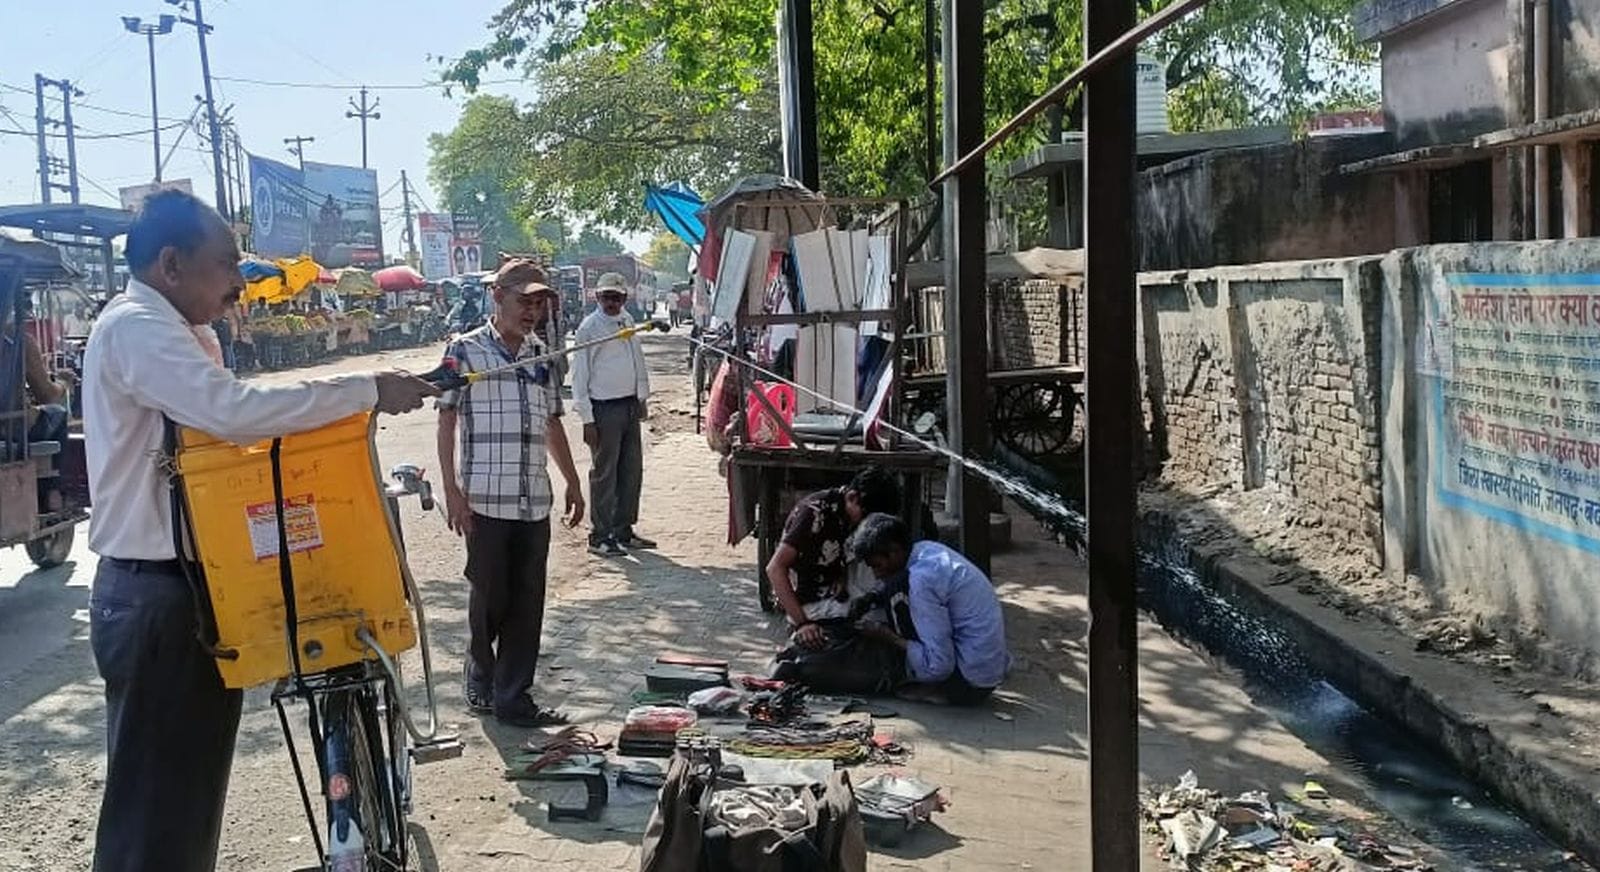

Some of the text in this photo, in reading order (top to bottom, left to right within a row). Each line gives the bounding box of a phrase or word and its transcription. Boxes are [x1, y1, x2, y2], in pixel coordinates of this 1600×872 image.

[1508, 288, 1534, 326] होने
[1535, 295, 1556, 325] पर
[1559, 295, 1589, 326] क्या
[1459, 457, 1479, 488] जिला
